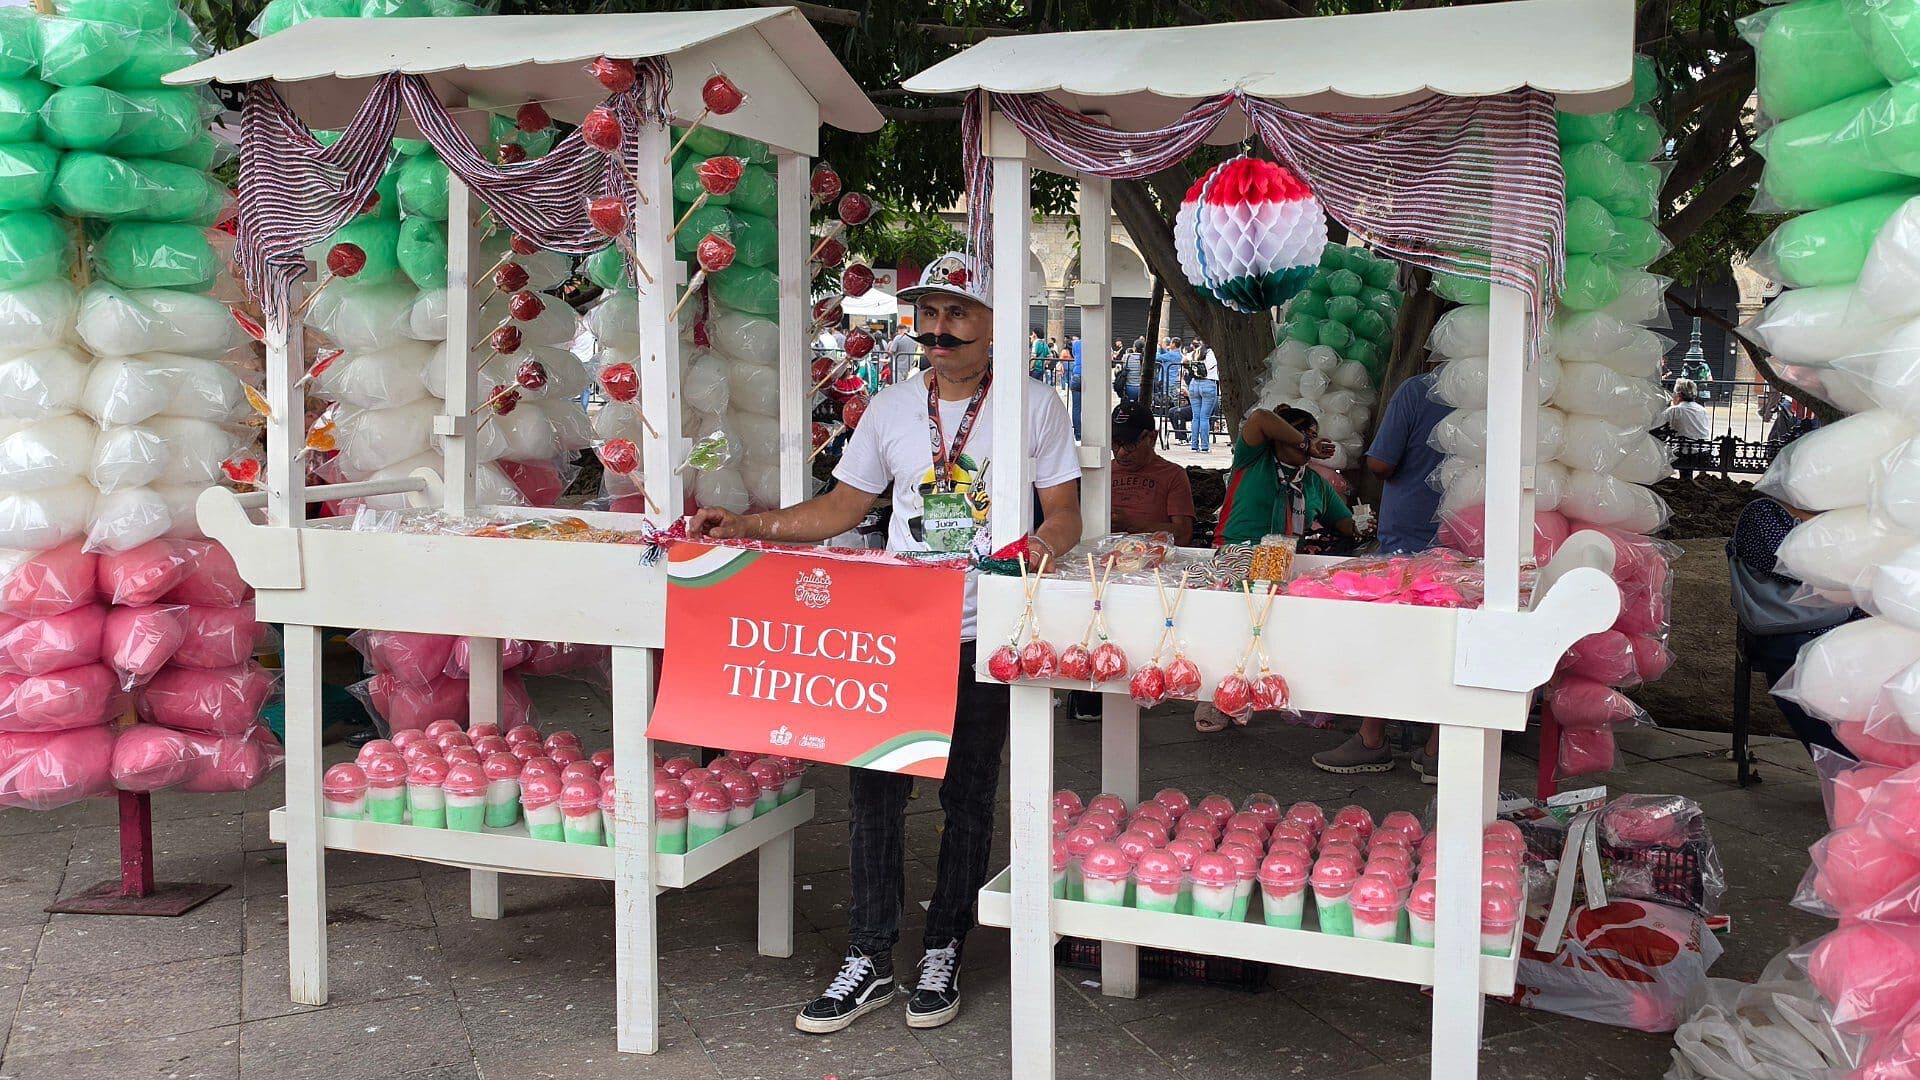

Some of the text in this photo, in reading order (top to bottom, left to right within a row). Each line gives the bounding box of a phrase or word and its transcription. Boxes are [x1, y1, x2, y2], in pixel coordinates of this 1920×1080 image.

[935, 520, 958, 528] Juan
[728, 616, 898, 667] DULCES
[723, 660, 889, 715] TÍPICOS
